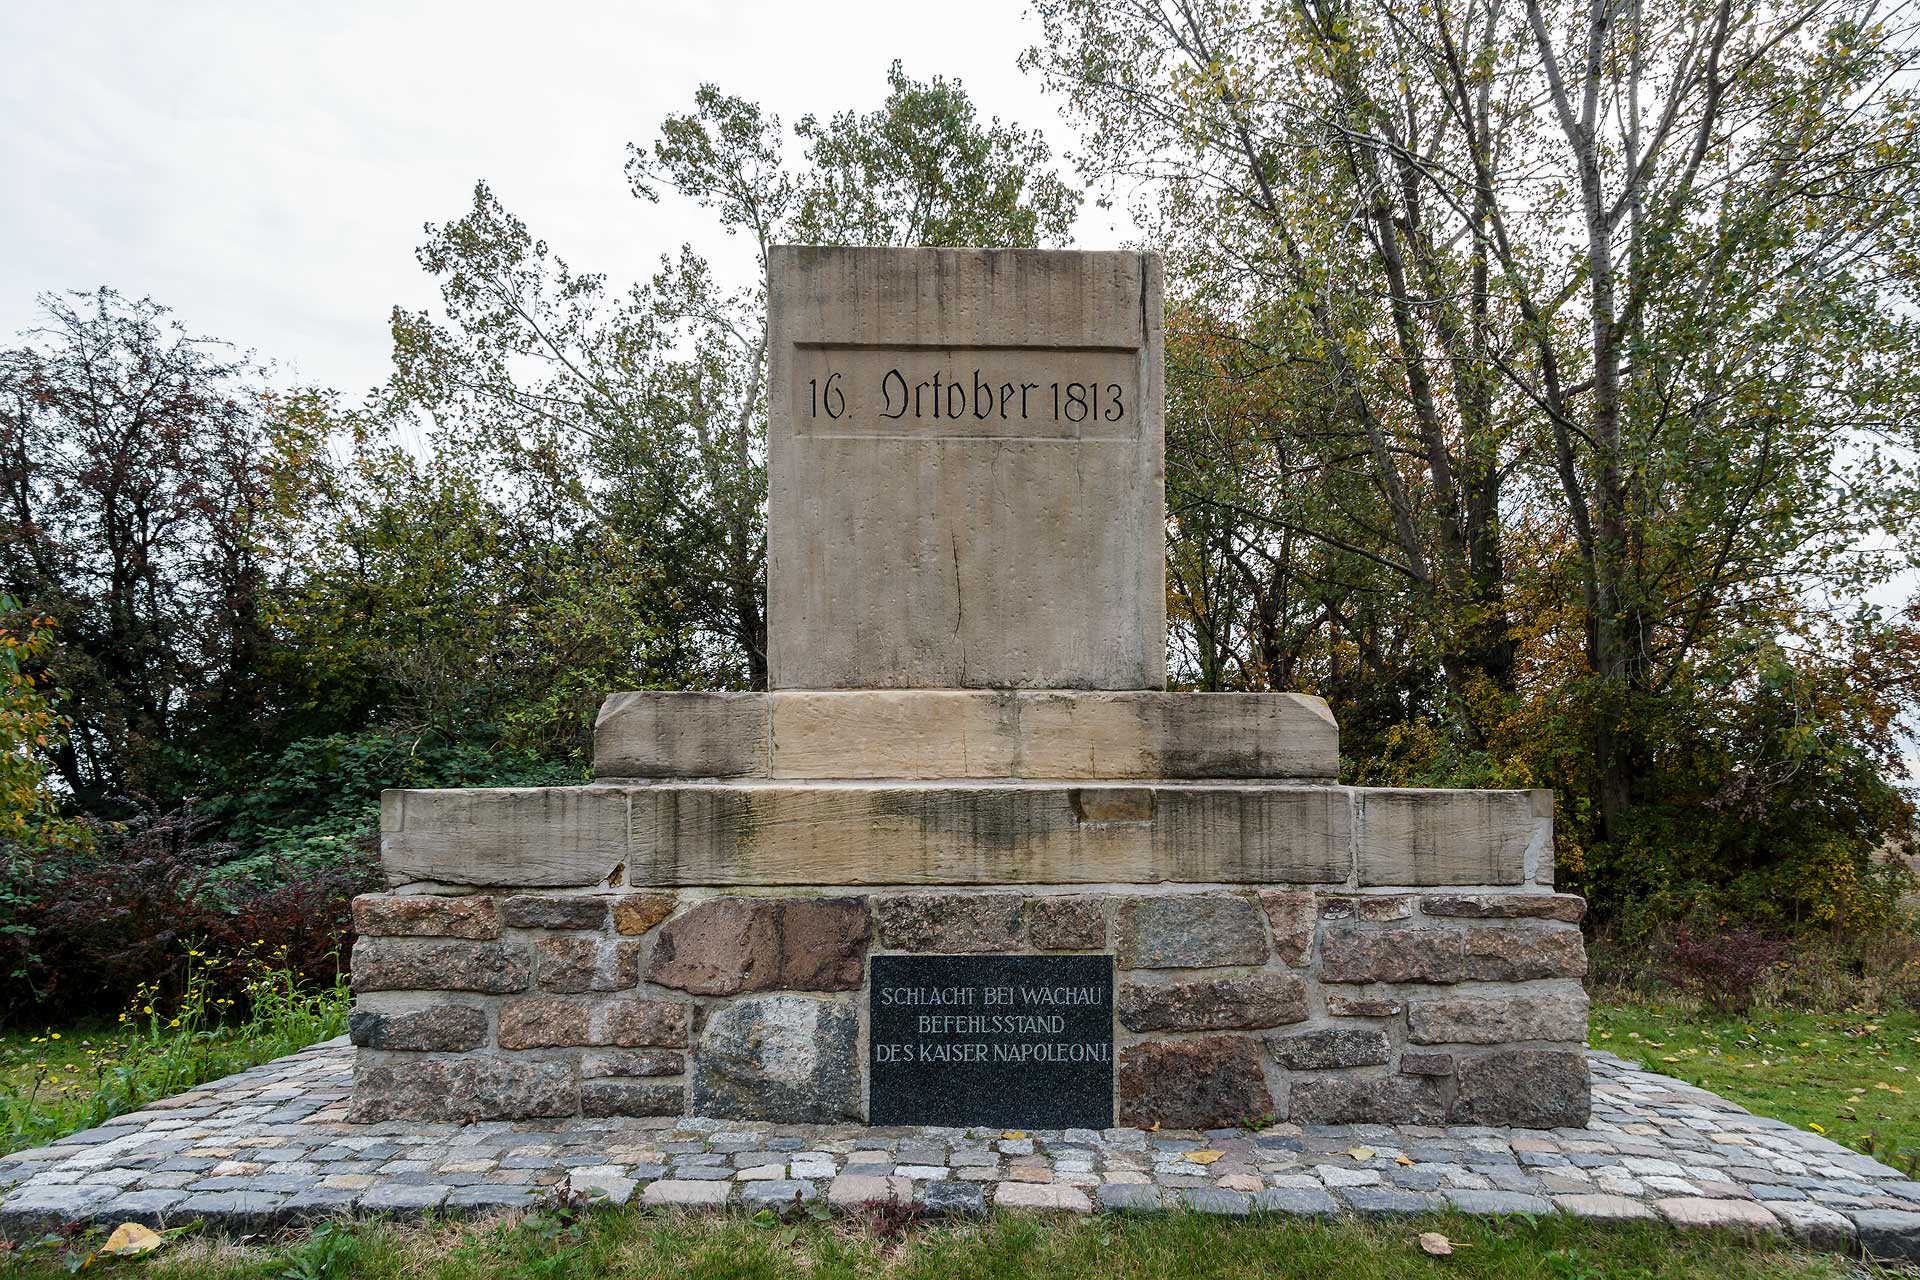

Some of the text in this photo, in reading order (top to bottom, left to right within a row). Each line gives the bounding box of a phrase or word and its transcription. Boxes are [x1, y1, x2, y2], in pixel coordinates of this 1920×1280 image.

[809, 368, 1124, 422] 16. October 1813
[881, 987, 1102, 1005] SCHLACHT BEI WACHAU
[918, 1015, 1065, 1033] BEFEHLSSTAND
[876, 1044, 914, 1062] DES
[919, 1044, 989, 1062] KAISER
